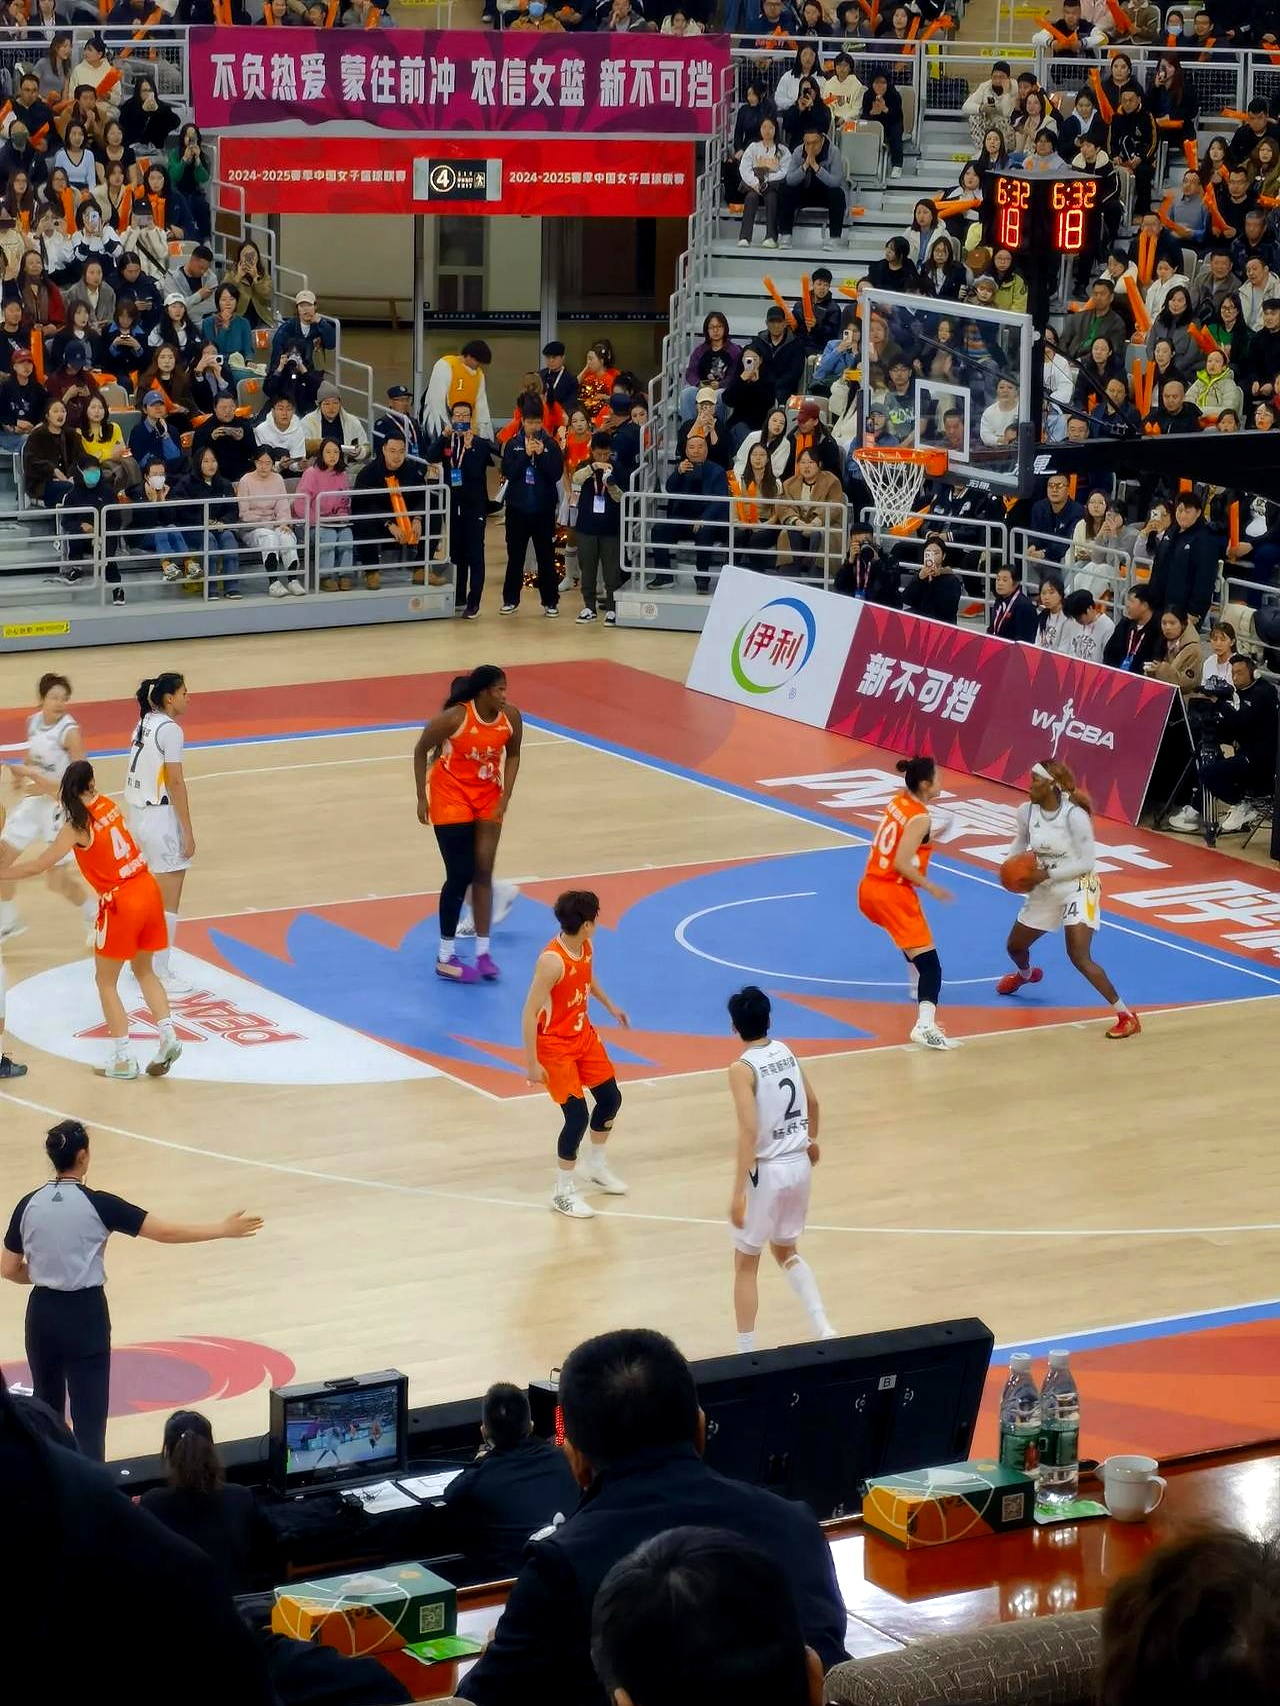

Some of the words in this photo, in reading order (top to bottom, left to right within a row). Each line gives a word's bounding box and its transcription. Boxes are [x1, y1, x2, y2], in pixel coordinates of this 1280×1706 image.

[210, 53, 327, 101] 不负热爱
[471, 57, 585, 107] 农信女篮
[599, 58, 713, 108] 新不可挡
[436, 169, 450, 188] 4
[997, 177, 1031, 209] 6:32
[1052, 181, 1097, 209] 6:32
[1001, 207, 1020, 248] 18
[1058, 209, 1083, 249] 18
[456, 378, 463, 390] 1
[743, 621, 804, 670] 伊利
[856, 652, 982, 723] 新不可挡
[130, 740, 145, 773] 7
[110, 826, 131, 860] 4
[573, 1011, 585, 1031] 3
[778, 1077, 802, 1120] 2
